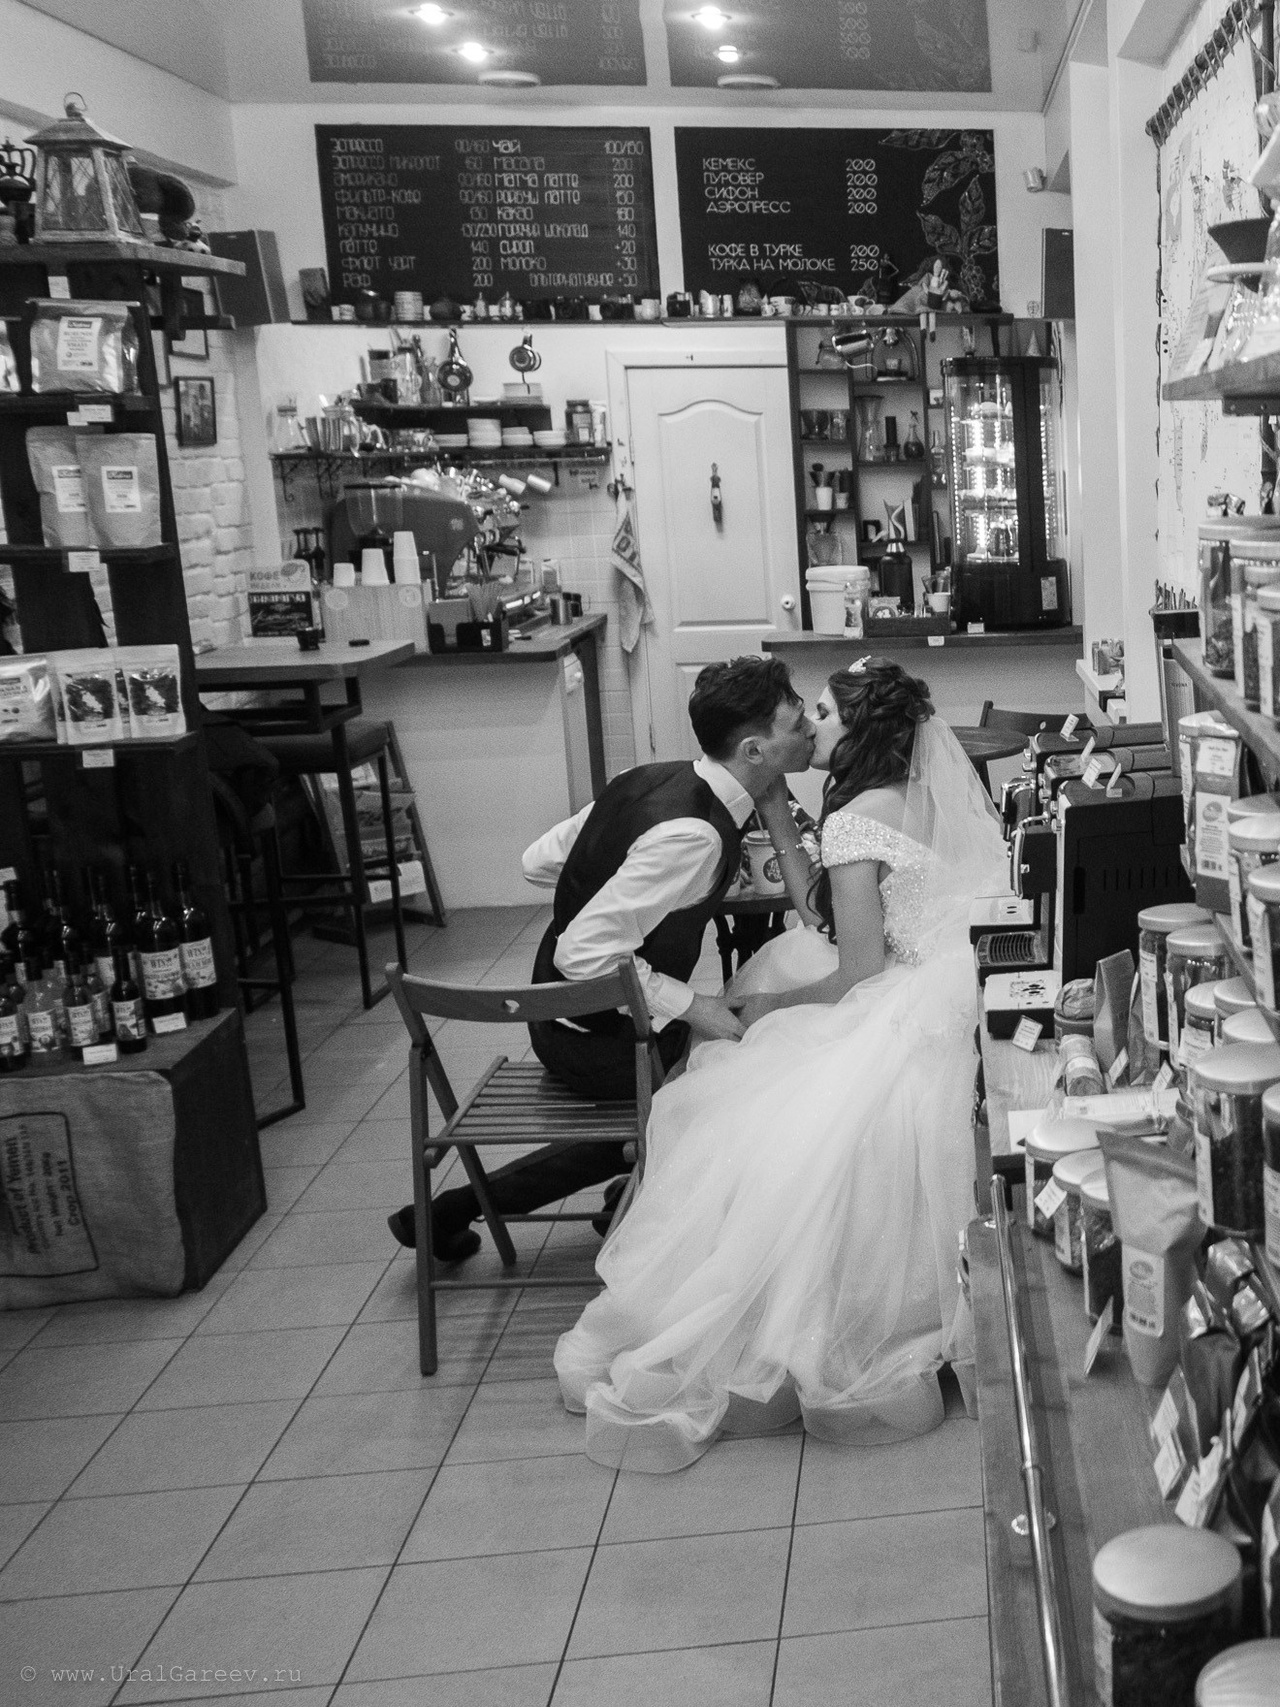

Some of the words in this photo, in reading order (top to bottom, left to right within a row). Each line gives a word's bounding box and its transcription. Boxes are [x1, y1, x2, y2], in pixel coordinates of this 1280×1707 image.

[702, 158, 756, 171] КЕМЕКС
[846, 159, 876, 172] 200
[703, 173, 764, 186] ПУРОВЕР
[847, 173, 878, 186] 200
[705, 187, 759, 200] СИФОН
[847, 188, 877, 200] 200
[706, 201, 791, 214] АЭРОПРЕСС
[848, 202, 878, 214] 200
[708, 244, 746, 257] КОФЕ
[750, 244, 759, 256] В
[763, 244, 803, 256] ТУРКЕ
[849, 245, 880, 257] 200
[710, 258, 750, 271] ТУРКА
[753, 258, 775, 271] НА
[779, 258, 836, 271] МОЛОКЕ
[850, 259, 879, 271] 250
[57, 1160, 72, 1191] 2011
